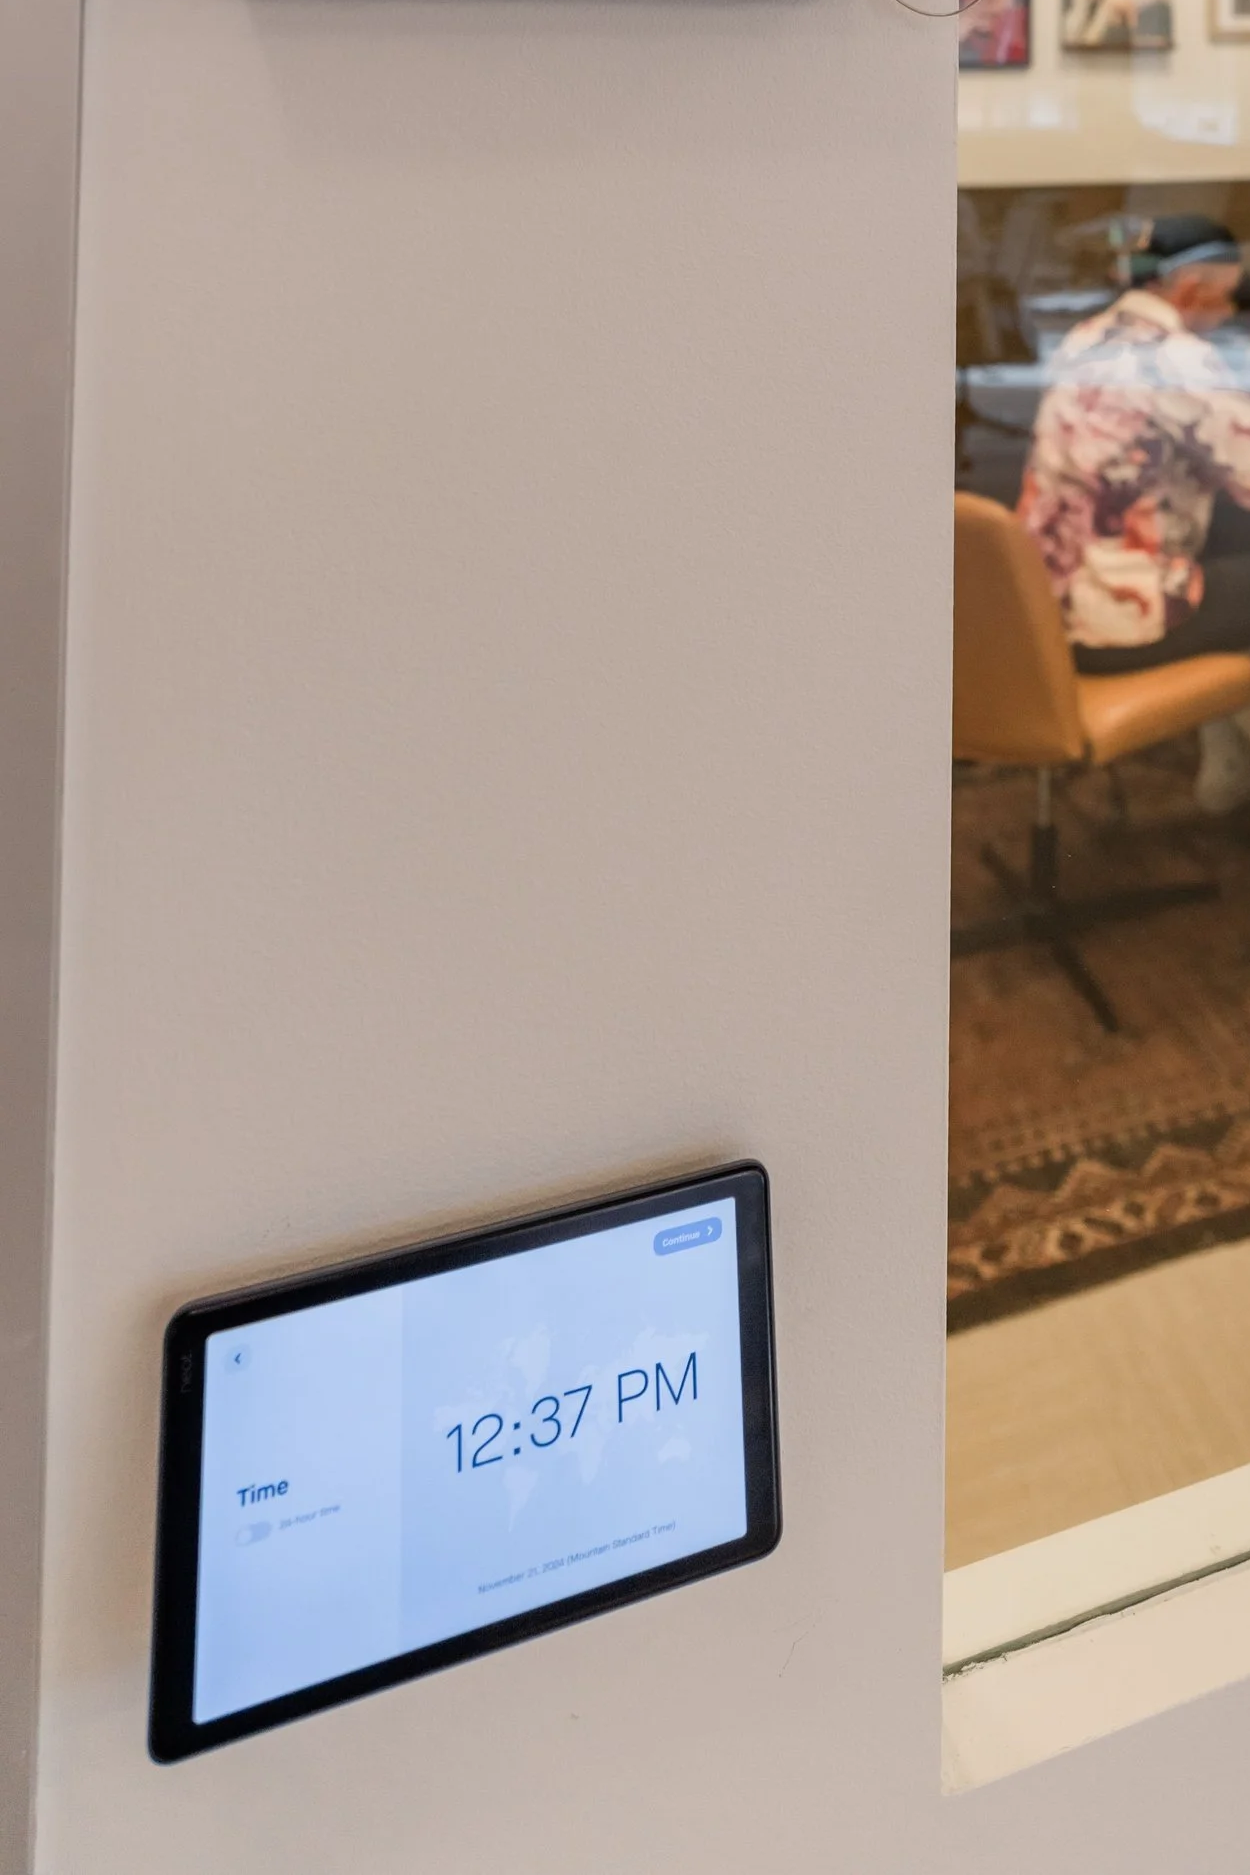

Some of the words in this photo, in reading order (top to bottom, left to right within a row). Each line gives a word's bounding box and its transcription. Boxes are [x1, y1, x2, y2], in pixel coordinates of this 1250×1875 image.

[662, 1230, 700, 1247] Continue
[447, 1384, 592, 1473] 12:37
[617, 1351, 697, 1423] PM
[237, 1480, 288, 1507] Time
[478, 1571, 525, 1594] November
[612, 1529, 650, 1549] Standard
